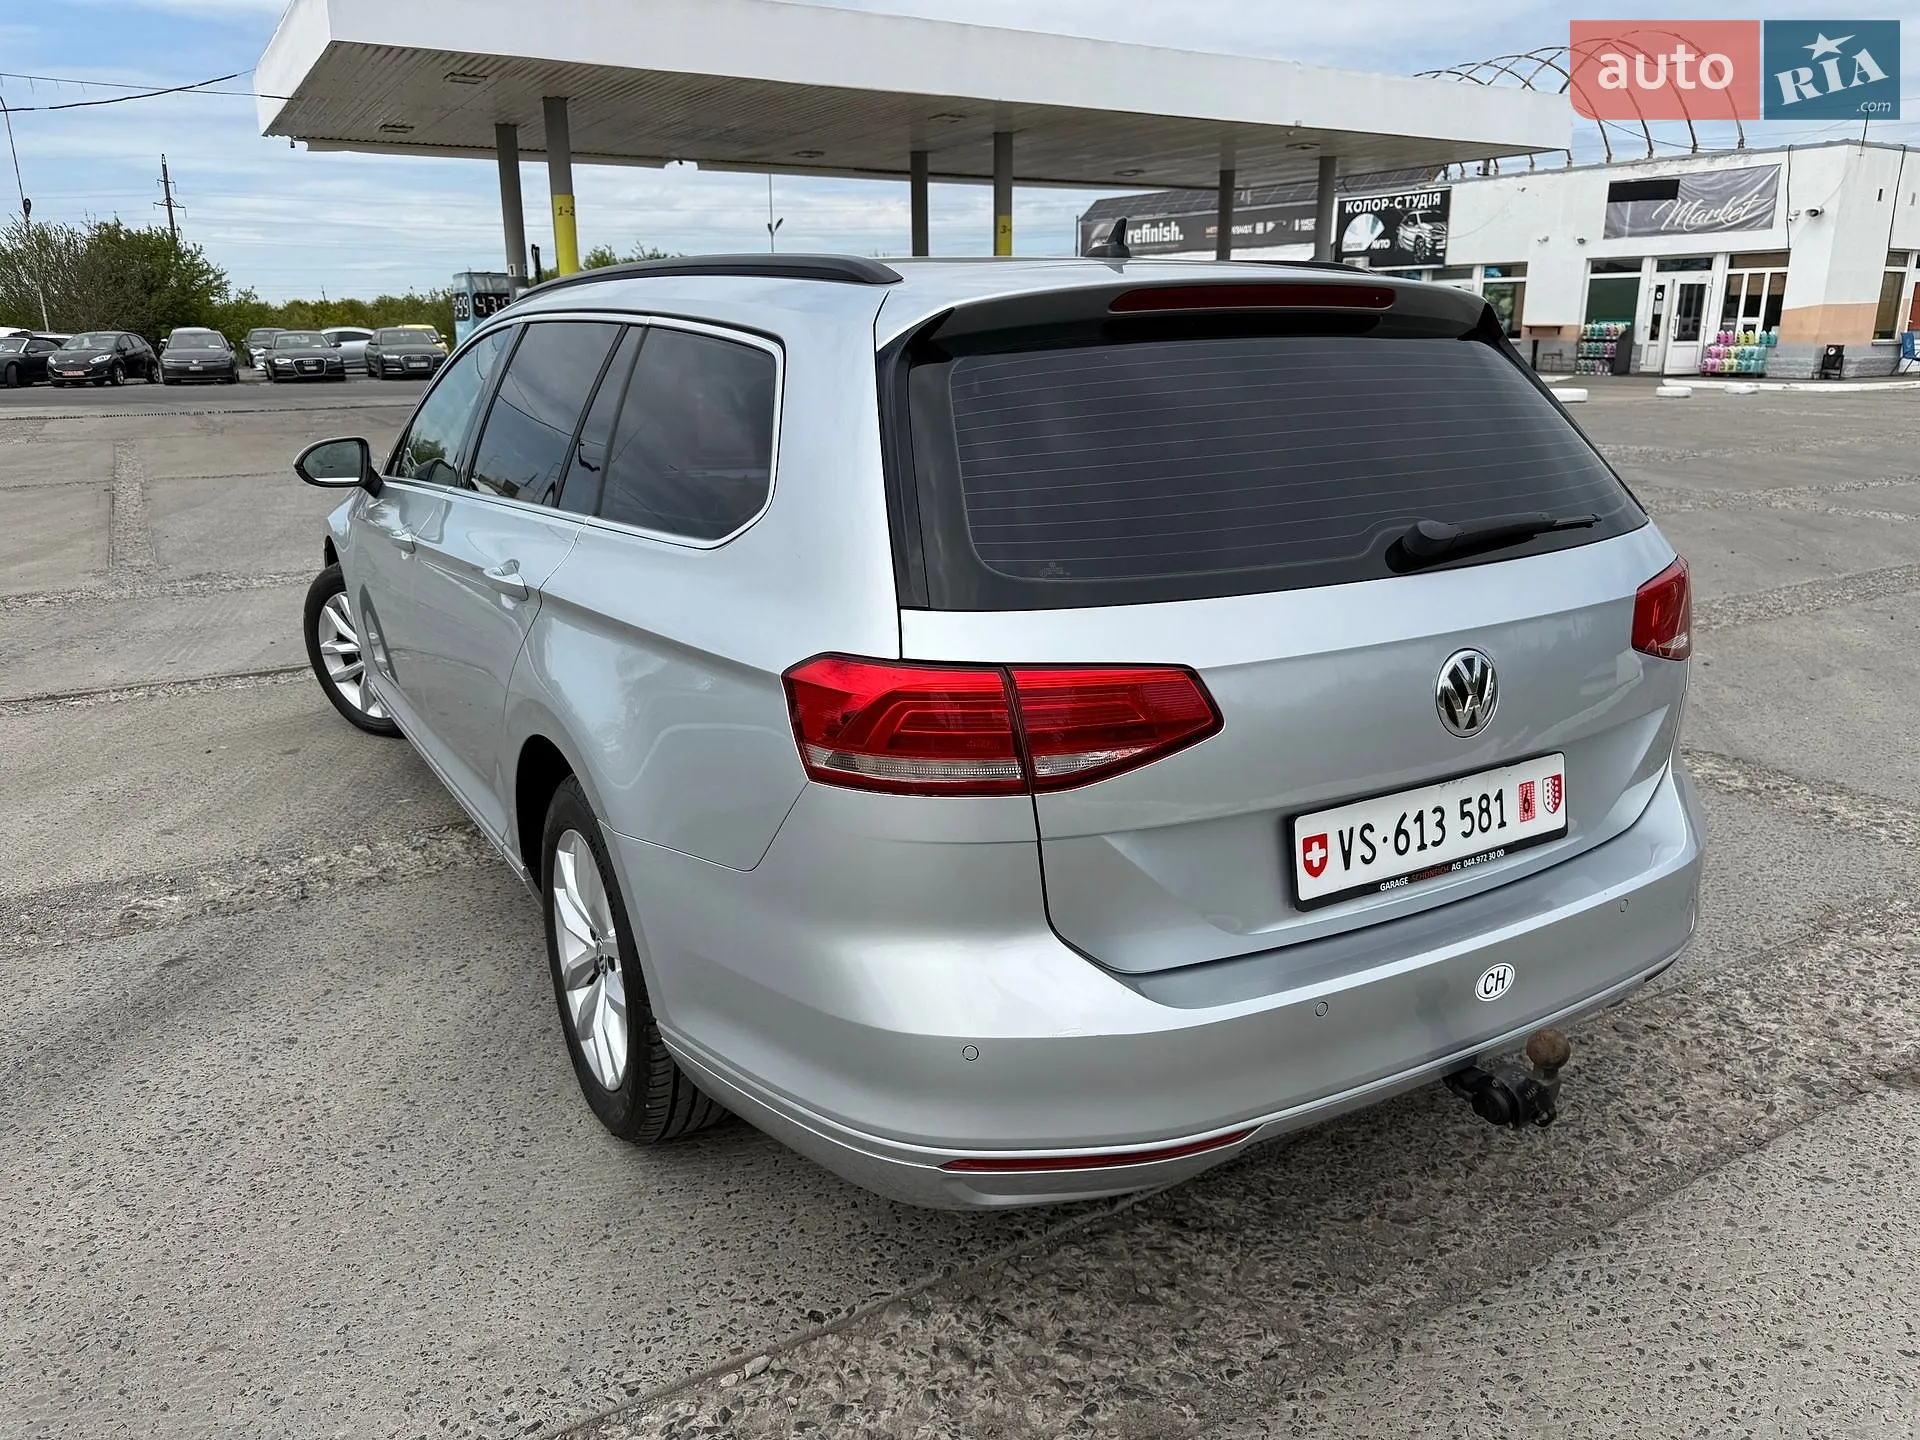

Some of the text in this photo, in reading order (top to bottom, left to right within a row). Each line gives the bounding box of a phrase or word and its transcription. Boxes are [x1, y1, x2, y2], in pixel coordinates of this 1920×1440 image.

[1345, 192, 1442, 214] КОЛОР-СТУДІЯ
[1651, 194, 1760, 232] Market
[1127, 221, 1185, 244] refinish.
[1438, 651, 1496, 735] VW
[1460, 788, 1507, 838] 581
[1380, 876, 1409, 891] GARAGE
[1451, 861, 1461, 872] AG
[1463, 854, 1488, 868] 044.972
[1484, 968, 1507, 995] CH
